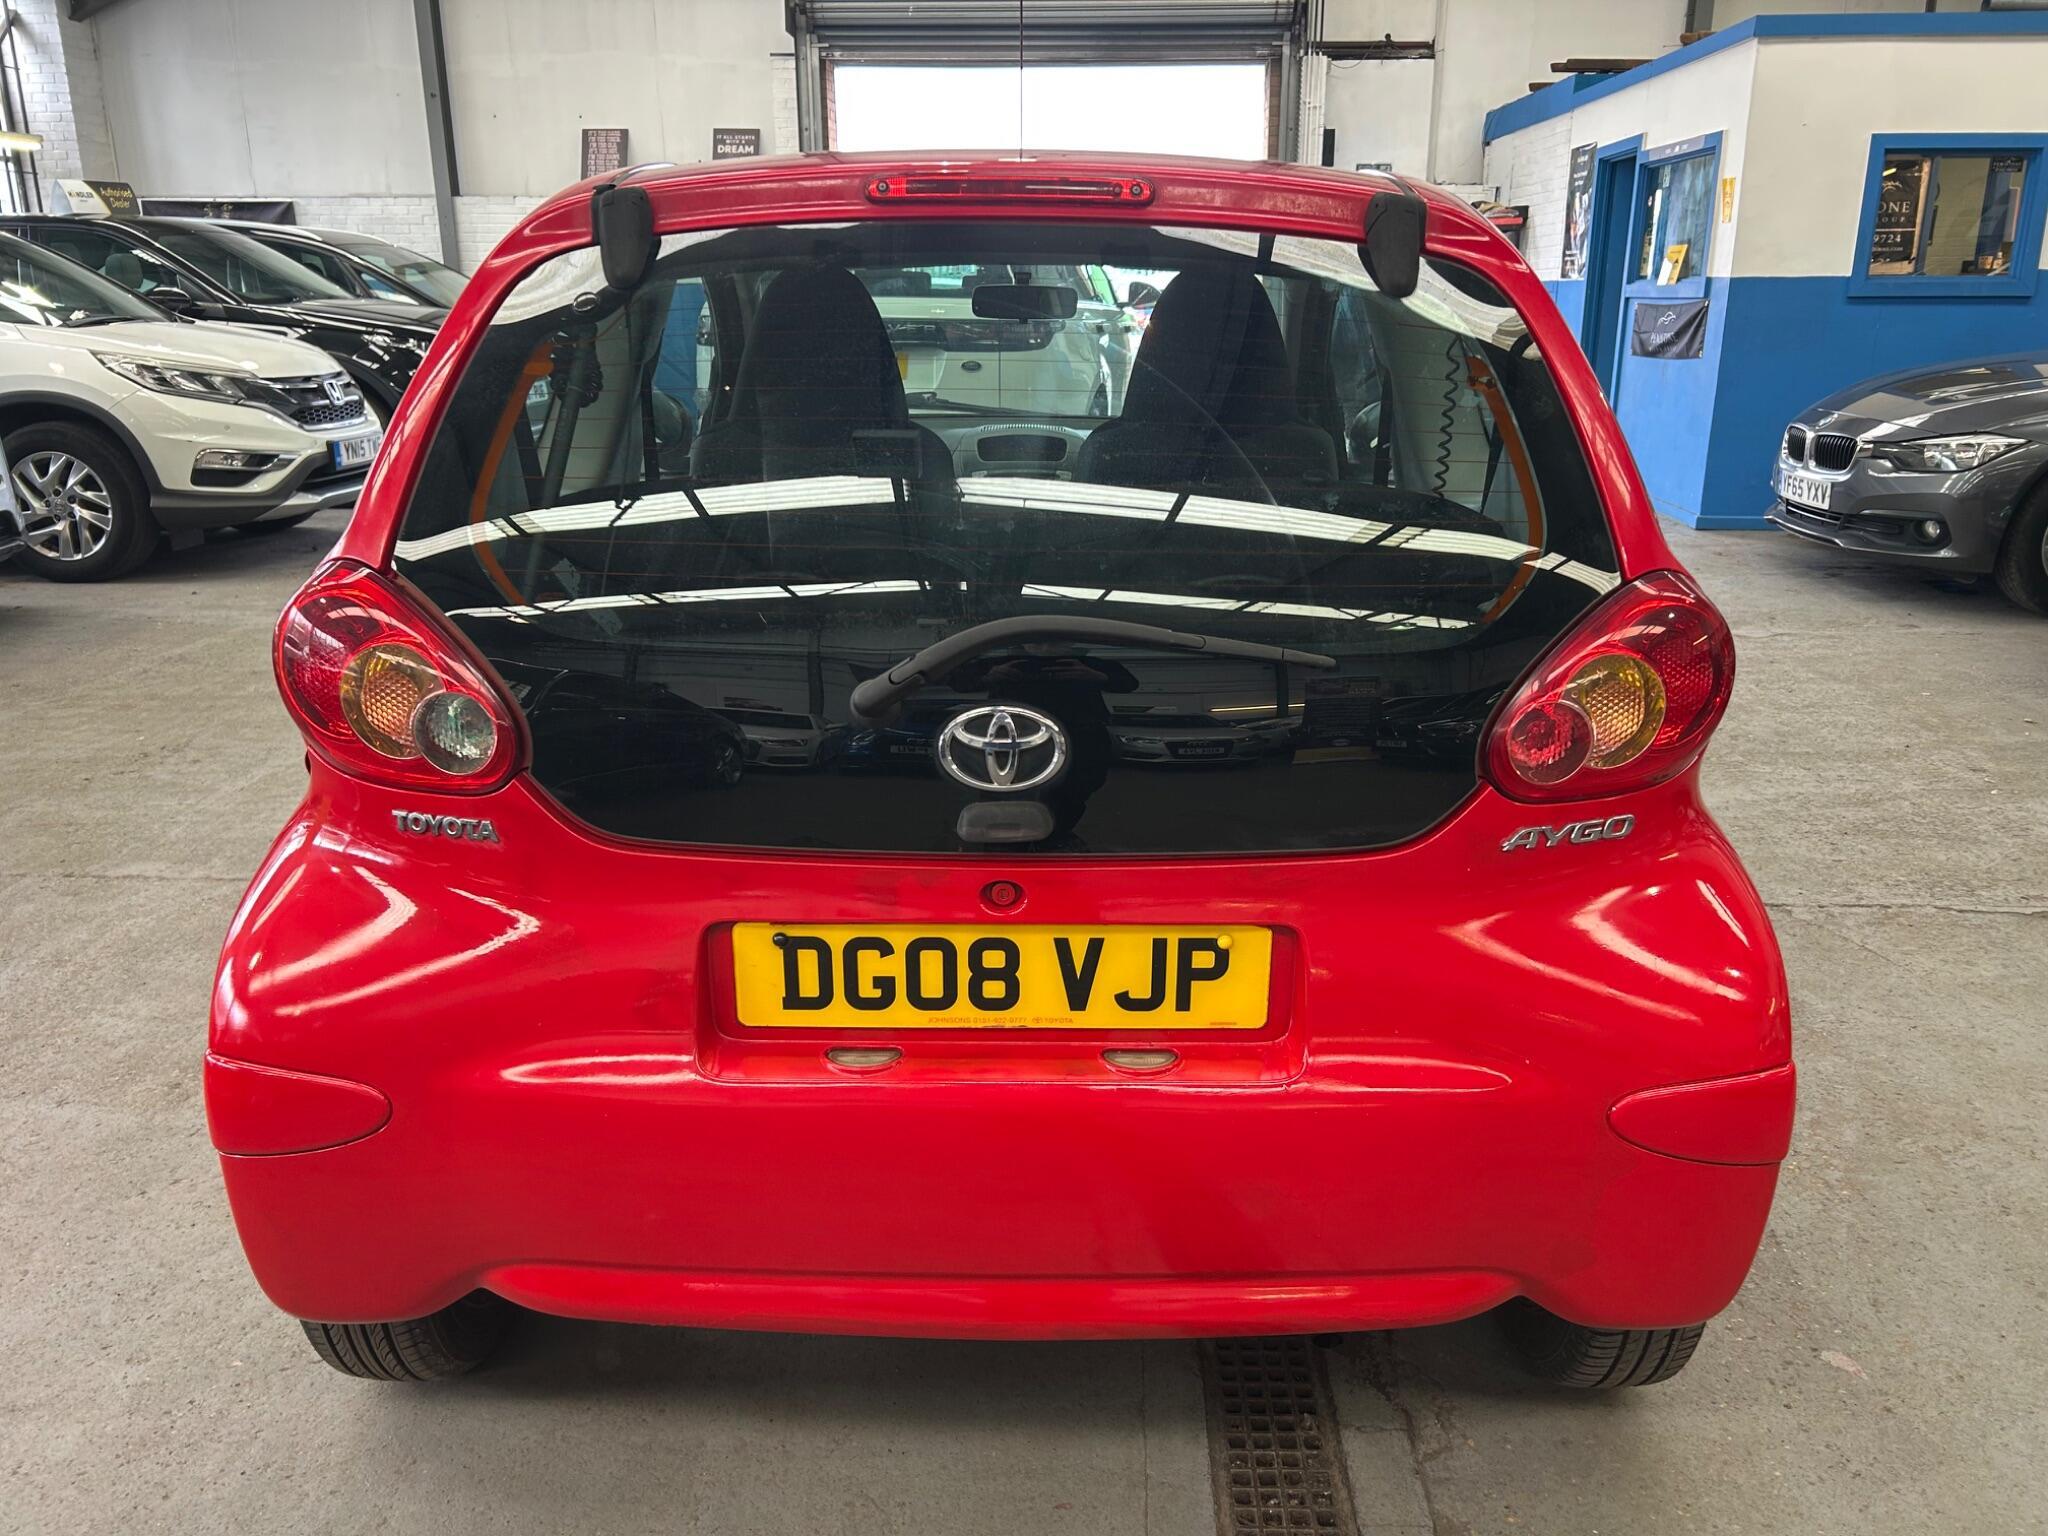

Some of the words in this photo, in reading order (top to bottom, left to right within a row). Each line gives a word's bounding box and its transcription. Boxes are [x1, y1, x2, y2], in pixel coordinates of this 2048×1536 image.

[717, 145, 754, 154] DREAM
[1783, 473, 1804, 498] YF65
[1806, 480, 1829, 505] YXV
[391, 809, 500, 843] TOYOTA
[1501, 814, 1636, 851] AYGO
[781, 935, 1021, 1011] DG08
[1053, 936, 1230, 1012] VJP
[928, 1016, 971, 1024] JOHNSONS
